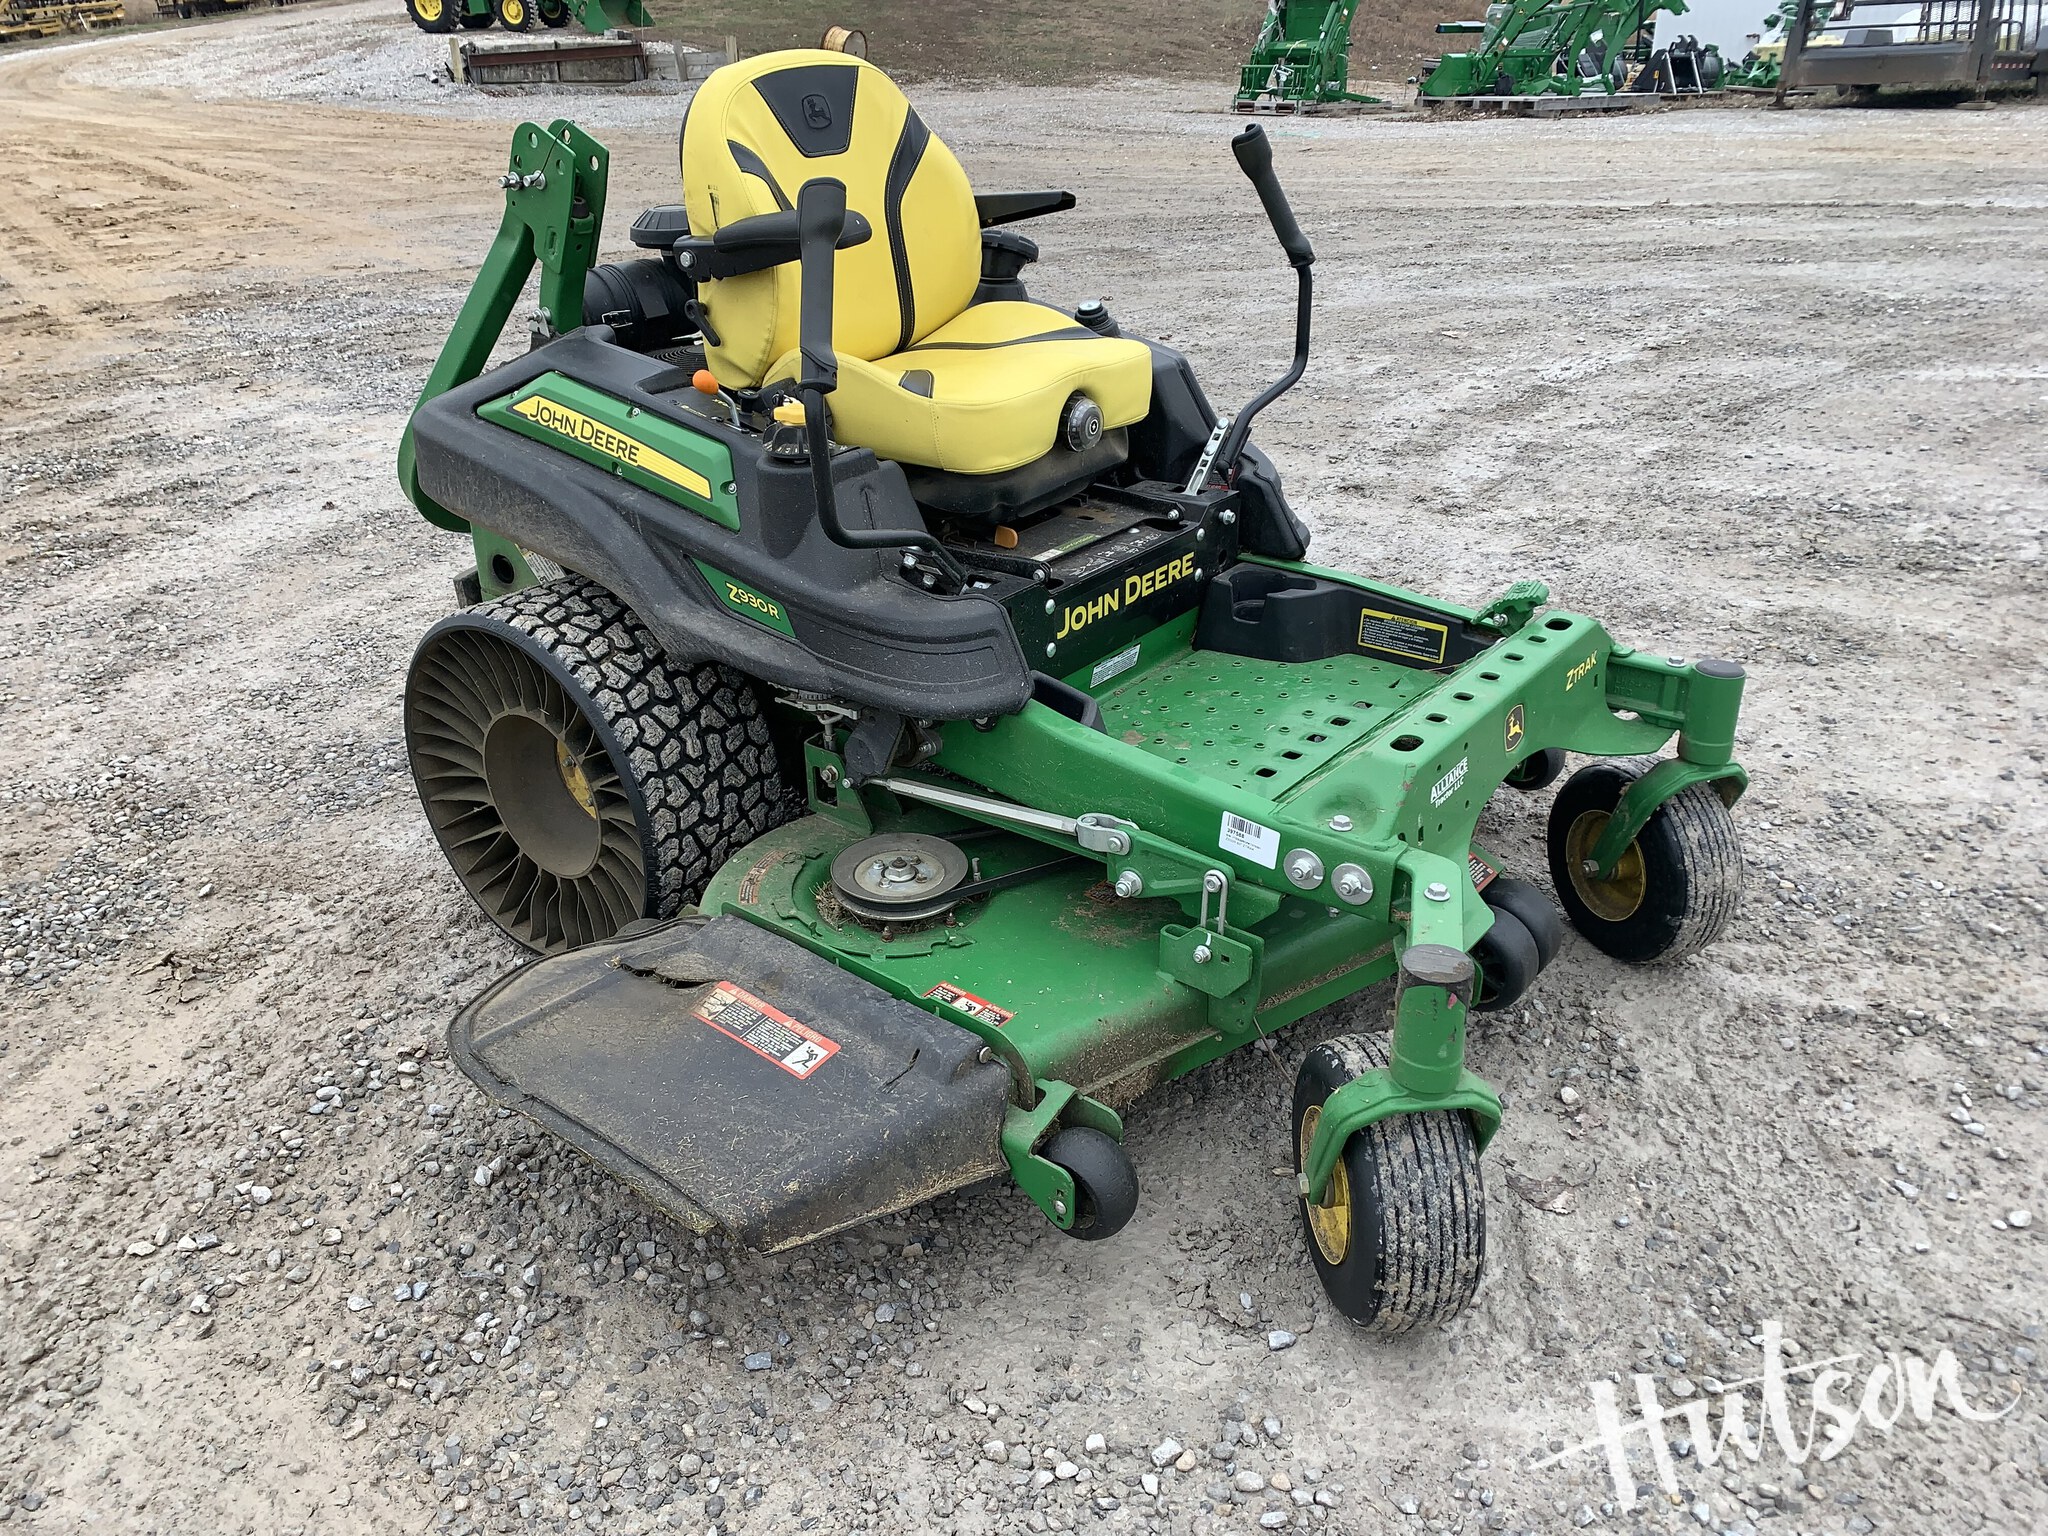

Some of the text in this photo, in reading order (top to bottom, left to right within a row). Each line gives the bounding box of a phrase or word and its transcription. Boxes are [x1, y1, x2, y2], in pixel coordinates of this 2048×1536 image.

[529, 400, 640, 464] JOHN DEERE
[725, 581, 780, 620] Z930R
[1056, 588, 1119, 640] JOHN
[1125, 551, 1195, 606] DEERE
[1430, 756, 1468, 804] ALLIANCE
[793, 1023, 824, 1044] PELIGRO
